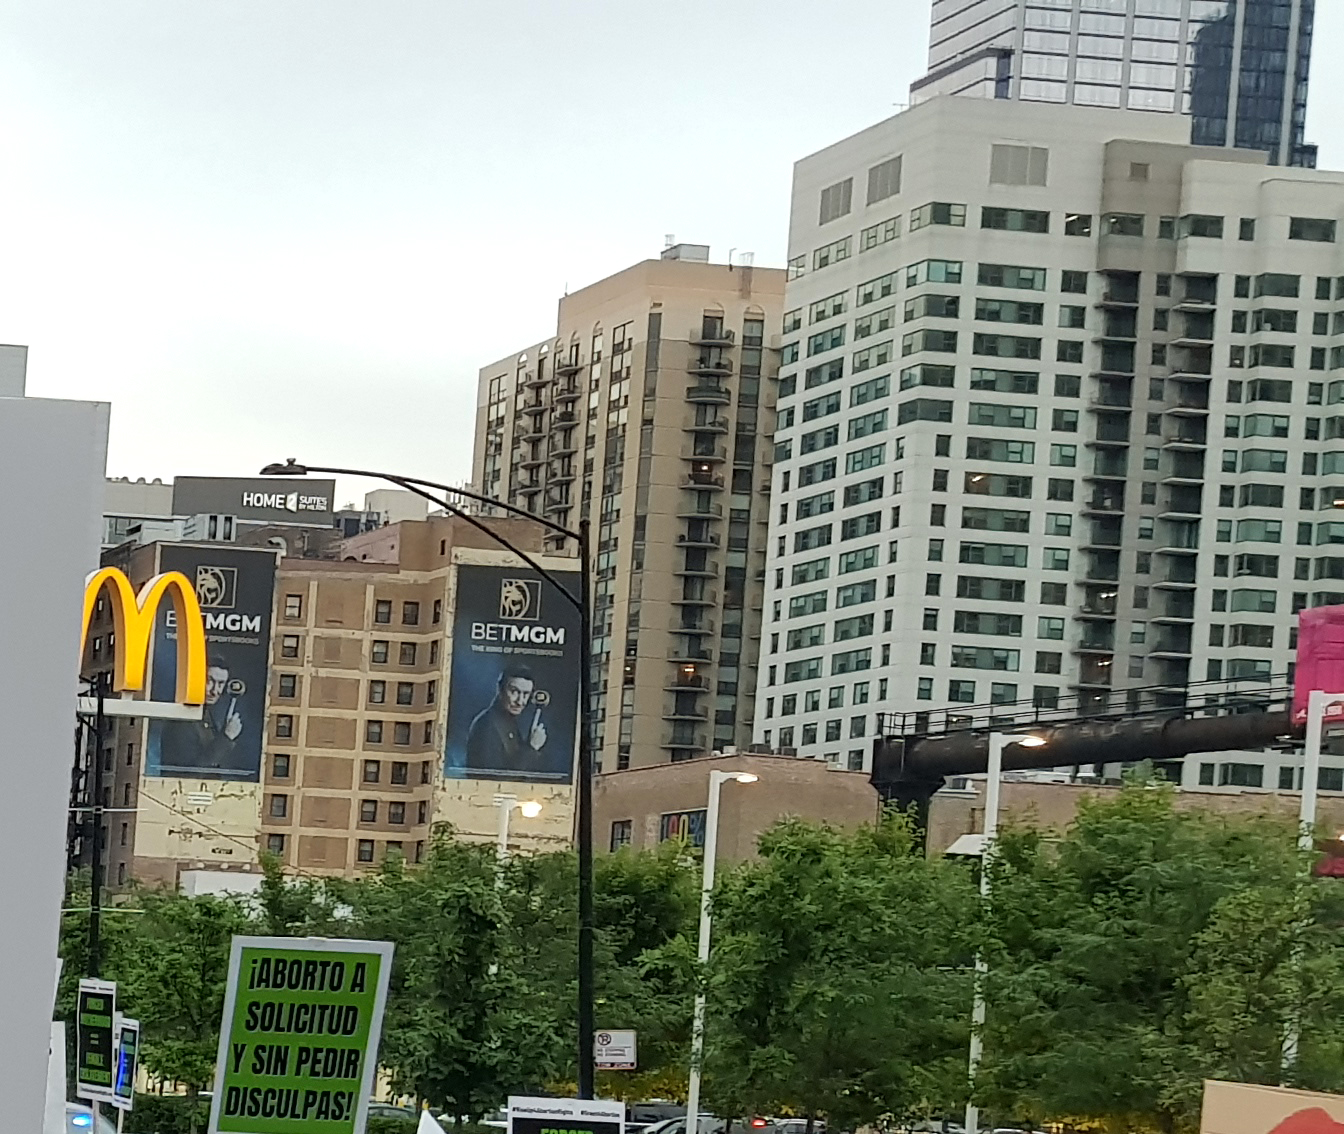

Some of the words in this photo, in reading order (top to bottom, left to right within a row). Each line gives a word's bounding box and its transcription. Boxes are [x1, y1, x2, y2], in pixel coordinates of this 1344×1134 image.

[243, 491, 285, 508] HOME
[471, 622, 565, 644] BETMGM
[248, 957, 345, 992] ¡ABORTO
[350, 962, 367, 993] A
[245, 1001, 358, 1036] SOLICITUD
[233, 1043, 247, 1074] Y
[251, 1044, 290, 1076] SIN
[295, 1046, 360, 1079] PEDIR
[225, 1086, 354, 1120] DISCULPAS!
